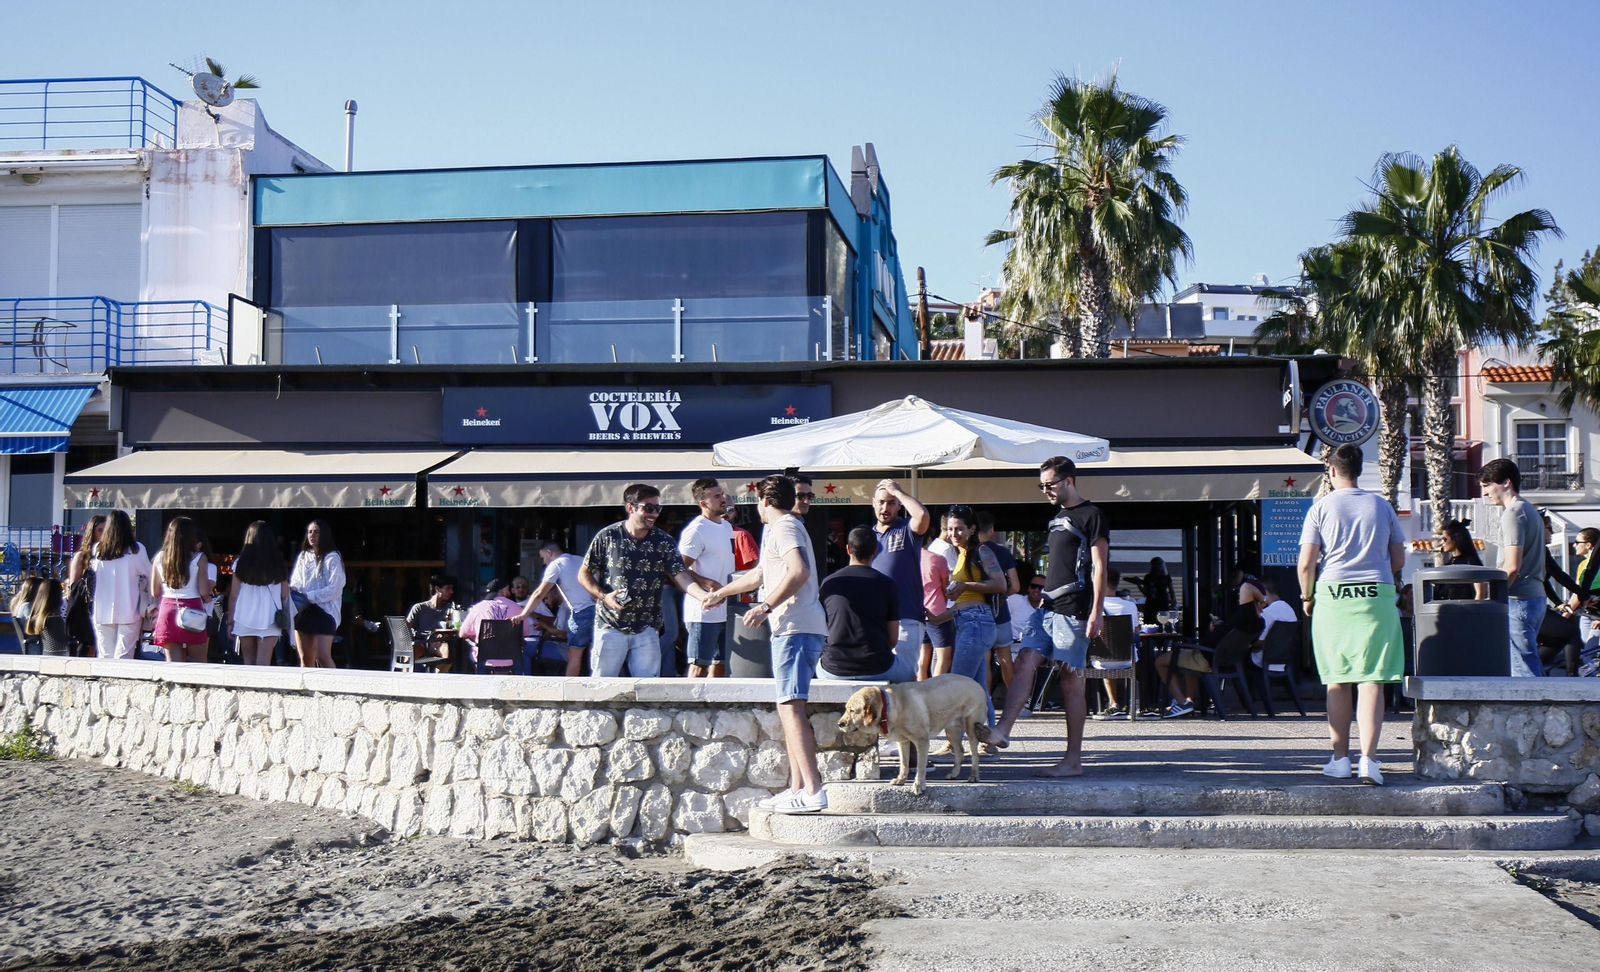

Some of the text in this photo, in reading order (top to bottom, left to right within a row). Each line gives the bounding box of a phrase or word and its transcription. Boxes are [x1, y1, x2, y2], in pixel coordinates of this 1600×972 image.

[589, 389, 682, 402] COCTELERÍA
[1316, 384, 1372, 409] PAULANER
[589, 402, 682, 431] VOX
[770, 416, 811, 425] Heineken
[462, 418, 502, 427] Heineken
[589, 432, 621, 440] BEERS
[622, 432, 631, 440] &
[365, 498, 406, 506] Heineken
[439, 498, 480, 506] Heineken
[731, 494, 758, 503] Heine
[75, 500, 115, 508] Heineken
[1264, 553, 1282, 564] PARA
[1328, 582, 1379, 600] VANS
